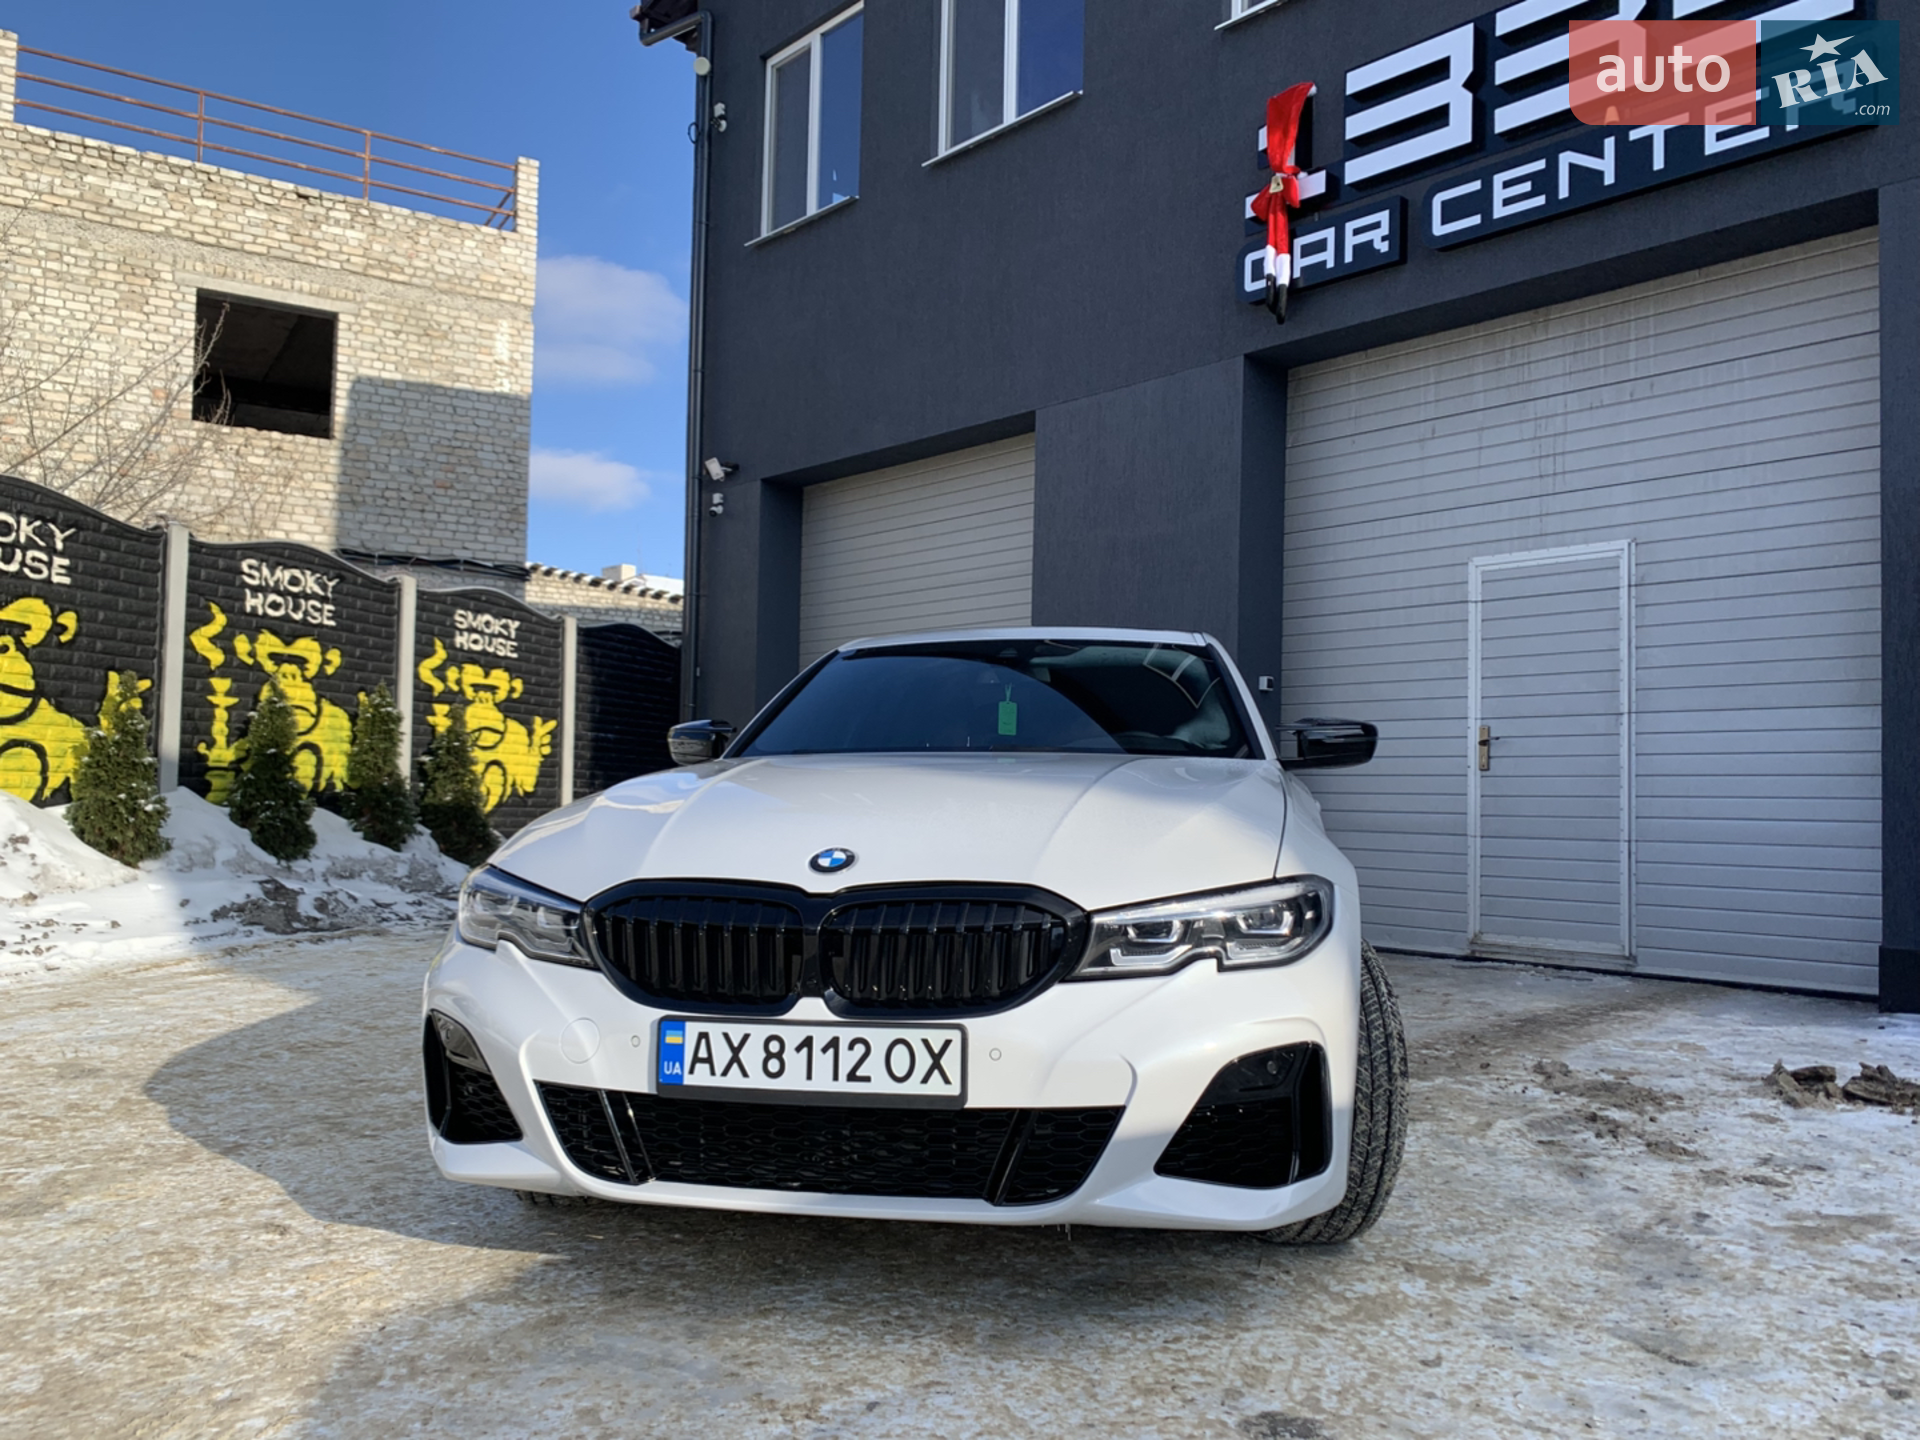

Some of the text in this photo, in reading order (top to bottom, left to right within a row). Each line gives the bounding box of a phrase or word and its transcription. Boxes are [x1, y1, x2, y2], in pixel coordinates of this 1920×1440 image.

[1244, 209, 1390, 292] CAR
[241, 558, 340, 599] SMOKY
[244, 588, 337, 626] HOUSE
[453, 609, 521, 639] SMOKY
[454, 630, 519, 658] HOUSE
[664, 1061, 682, 1075] UA
[688, 1031, 953, 1085] AX 8112 OX
